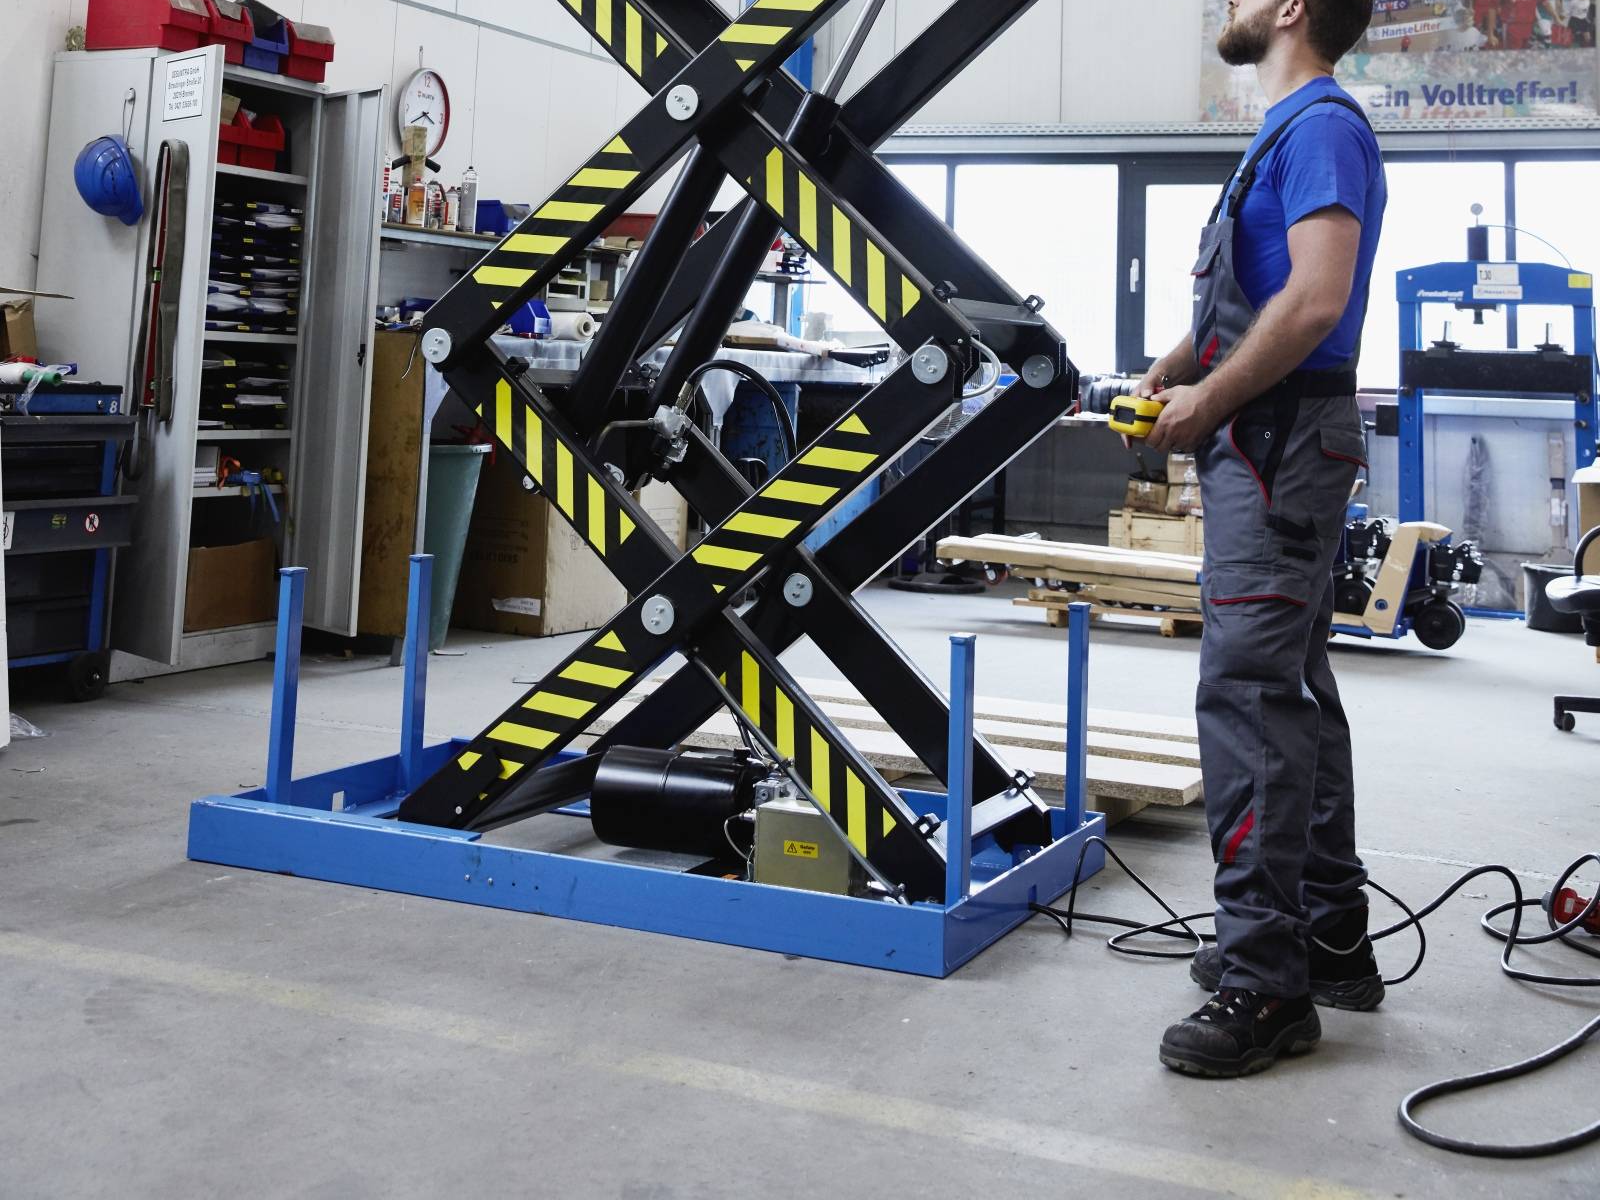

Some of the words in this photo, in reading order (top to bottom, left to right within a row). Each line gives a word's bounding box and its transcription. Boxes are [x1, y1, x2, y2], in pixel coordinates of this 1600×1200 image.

[1382, 22, 1440, 37] HanseLifter
[424, 75, 431, 88] 12
[1421, 81, 1577, 107] Volltreffer!
[109, 400, 118, 414] 8
